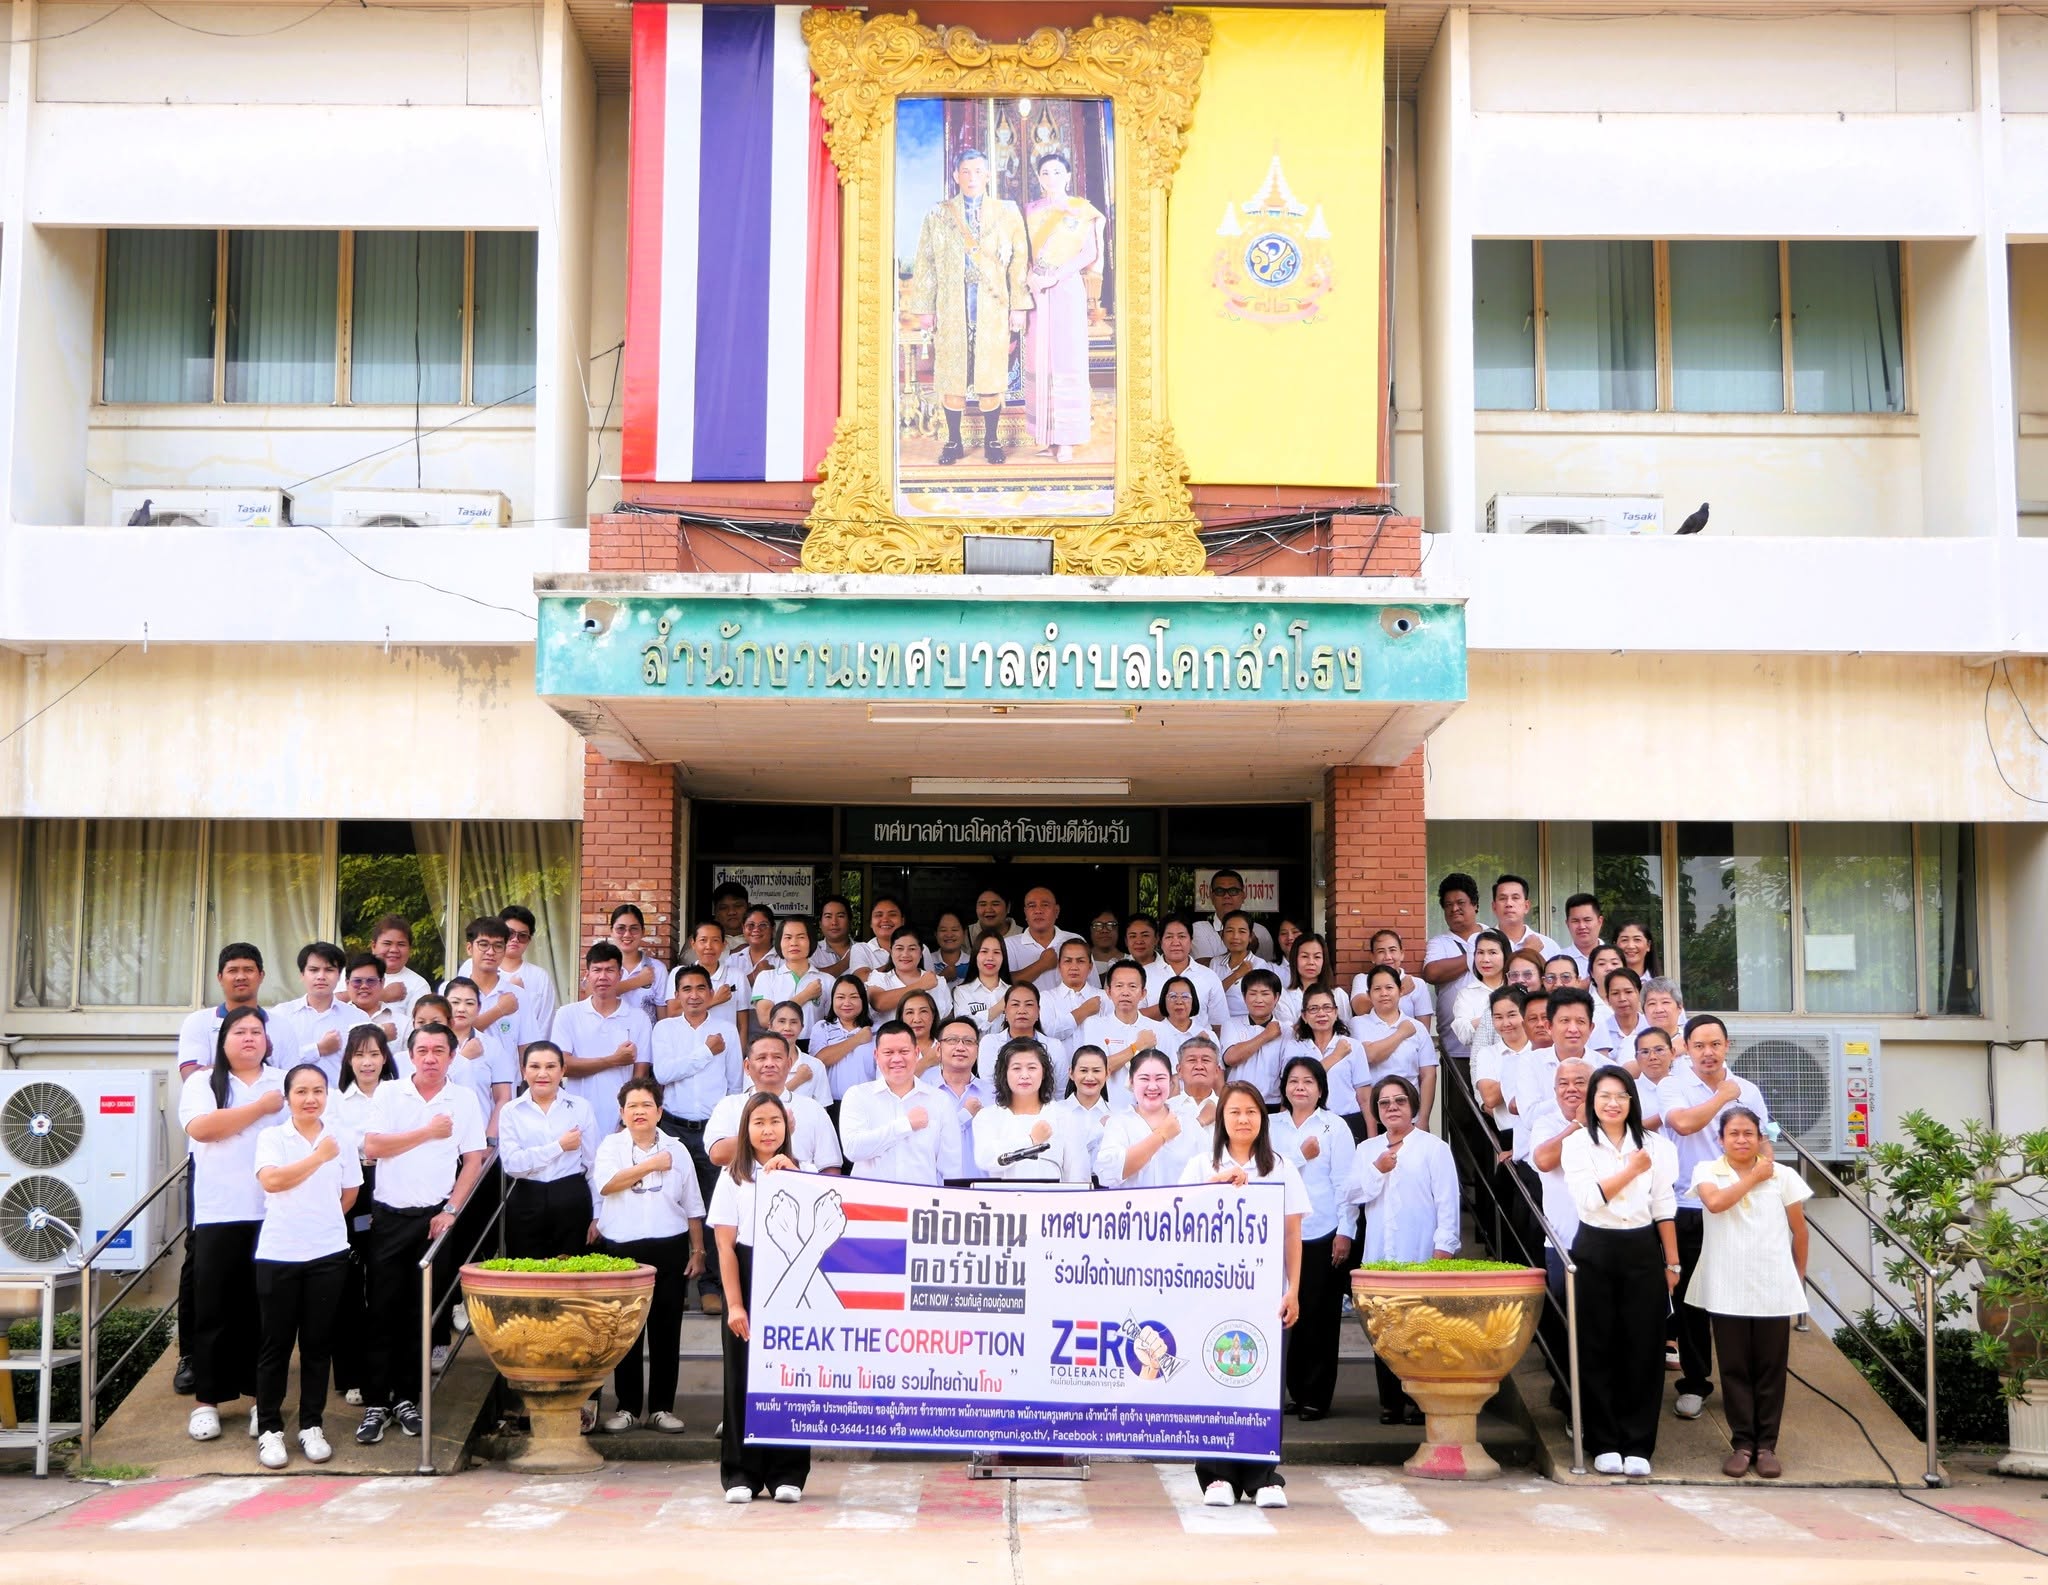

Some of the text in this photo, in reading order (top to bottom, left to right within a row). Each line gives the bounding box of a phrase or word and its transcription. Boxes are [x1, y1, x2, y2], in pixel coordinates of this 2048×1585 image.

[237, 504, 271, 514] Tasaki
[457, 507, 492, 518] Tasaki
[1622, 511, 1657, 521] Tasaki
[641, 616, 1362, 690] สำนักงานเทศบาลตำบลโคกสำโรง
[874, 817, 1130, 843] เทศบาลตำบลโคกสำโรงยินดีต้อนรับ
[717, 869, 811, 888] ศนย์ข้อมูลการท่องเที่ยว
[912, 1198, 1027, 1247] ต่อต้าน
[1041, 1197, 1268, 1244] เทศบาลตำบลโคกสำโรง
[911, 1248, 1026, 1286] คอร์รัปชั่น
[912, 1293, 929, 1306] ACT
[930, 1294, 949, 1307] NOW
[763, 1325, 1025, 1357] BREAK THE CORRUPTION
[1050, 1366, 1125, 1379] TOLERANCE
[755, 1397, 781, 1412] พบเห็น
[875, 1401, 918, 1420] ของผู้บริหาร
[920, 1402, 956, 1417] ข้าราชการ
[958, 1404, 1016, 1418] พนักงานเทศบาล
[1018, 1406, 1084, 1424] พนักงานครูเทศบาล
[1085, 1406, 1118, 1421] เจ้าหน้าที่
[1120, 1408, 1143, 1426] ลูกจ้าง
[791, 1418, 828, 1433] โปรดแจ้ง
[831, 1424, 887, 1436] 0-3644-1146
[890, 1422, 906, 1436] หรือ
[1053, 1430, 1098, 1441] Facebook
[1106, 1429, 1199, 1444] เทศบาลตำบลโคกสำโรง
[1202, 1432, 1235, 1449] จ.ลพบุรี
